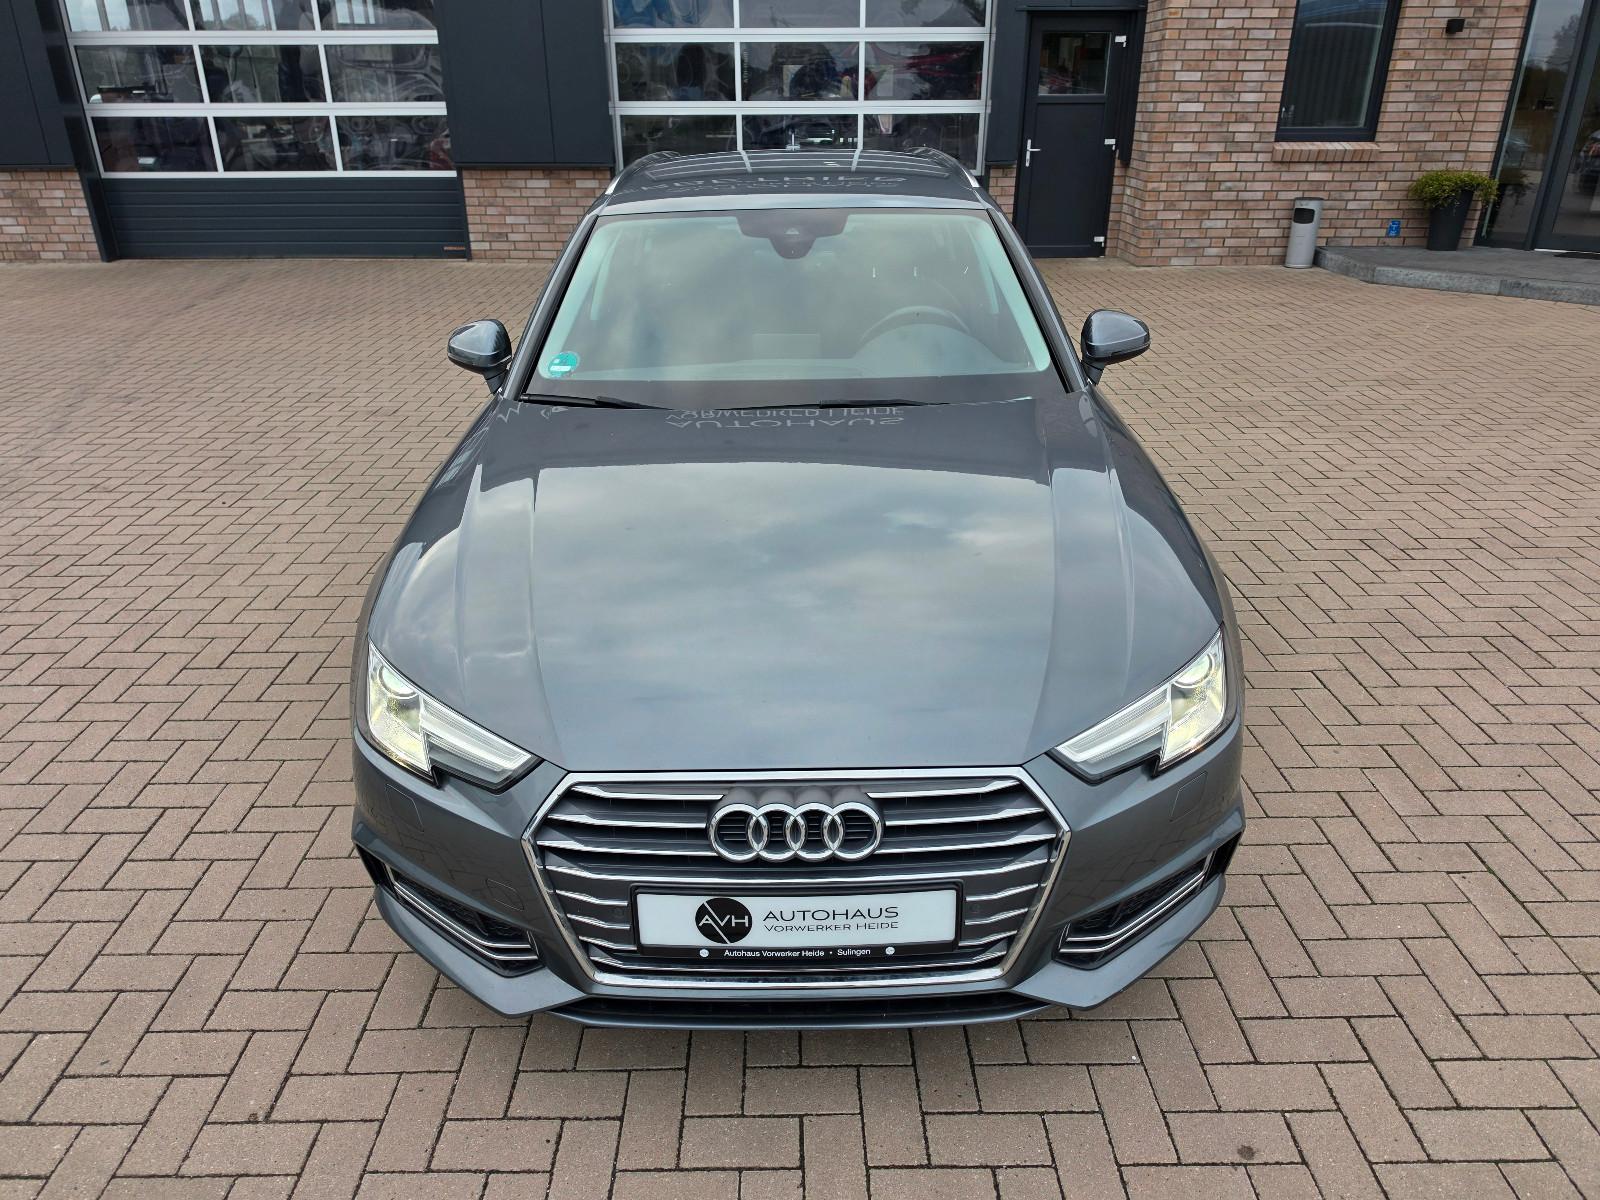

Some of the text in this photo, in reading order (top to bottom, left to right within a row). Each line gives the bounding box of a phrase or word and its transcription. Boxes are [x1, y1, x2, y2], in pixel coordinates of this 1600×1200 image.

[763, 906, 899, 922] AUTOHAUS
[764, 921, 899, 933] VORWERKER HEIDE
[723, 948, 871, 957] Autohaus Vorwerker Heide Sulingen
